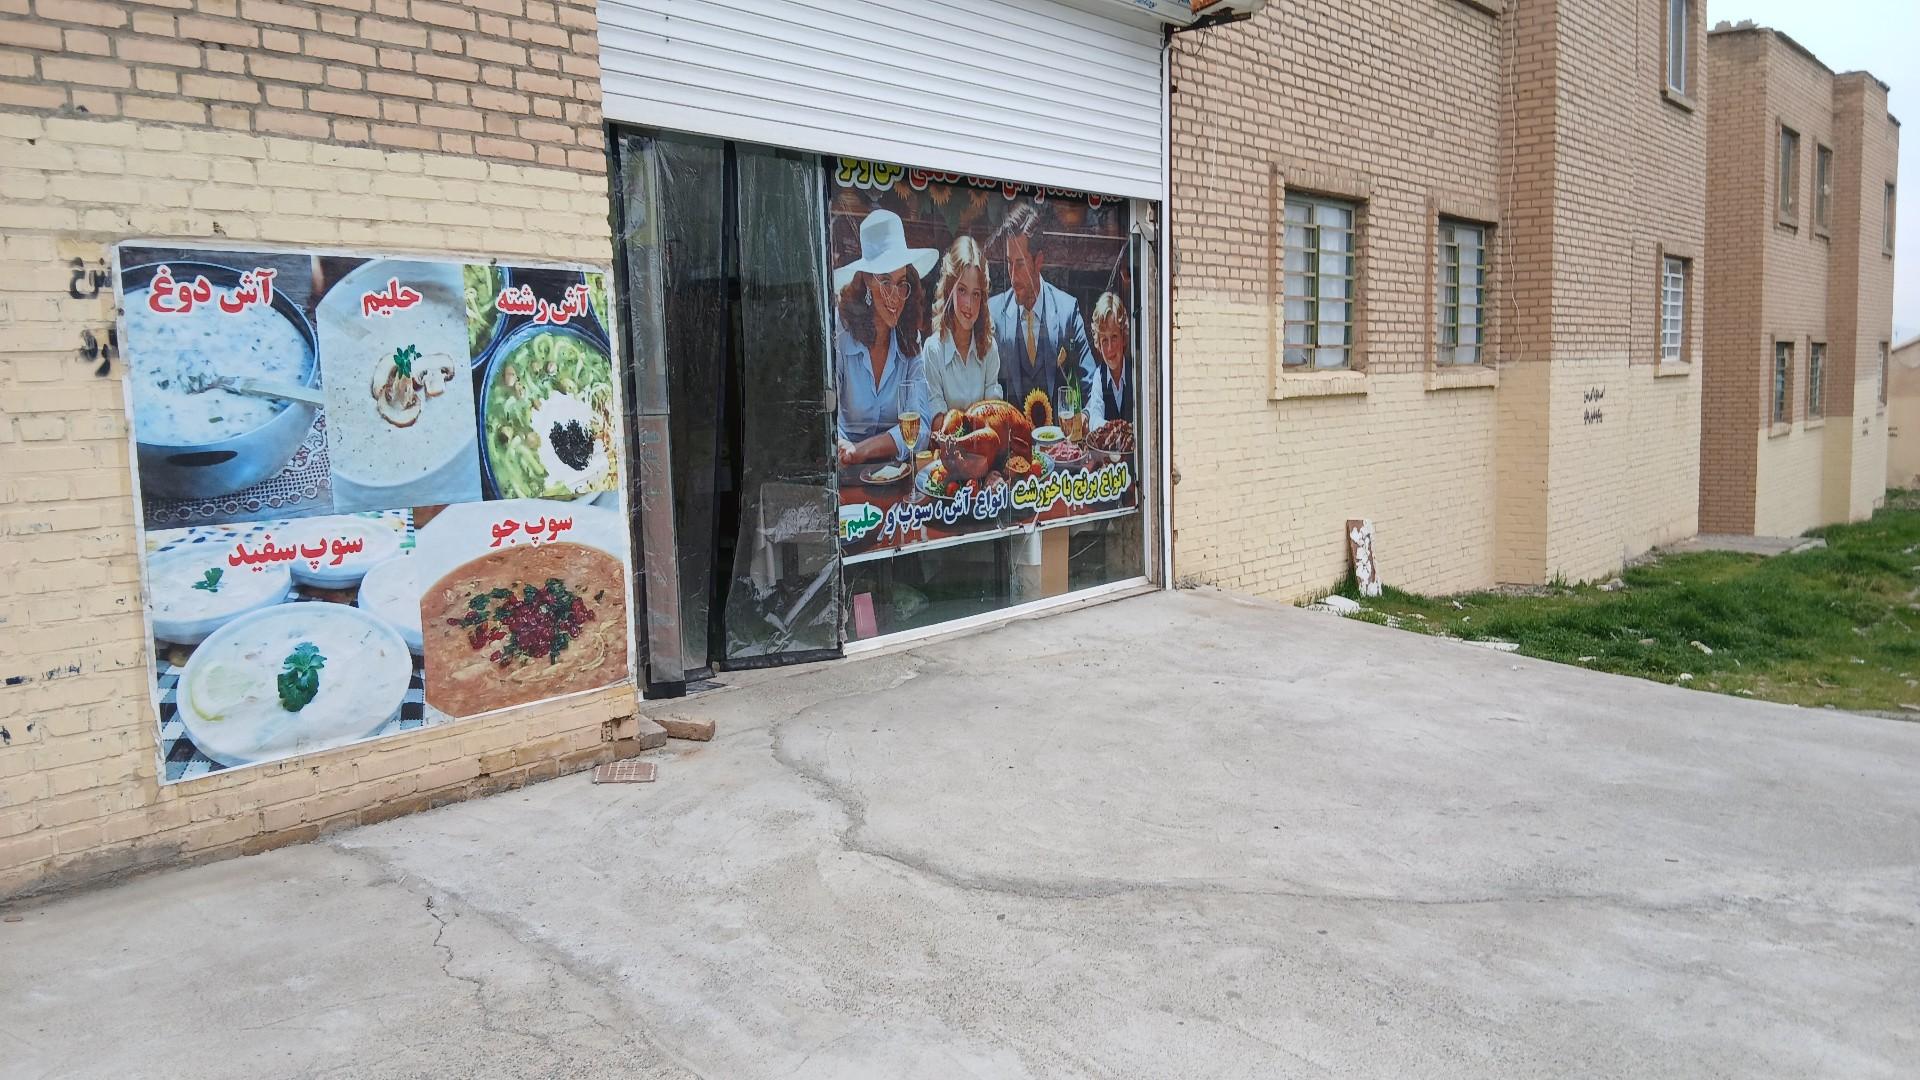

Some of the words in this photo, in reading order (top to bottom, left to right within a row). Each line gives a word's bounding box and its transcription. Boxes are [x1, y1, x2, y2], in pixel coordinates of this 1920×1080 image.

[149, 267, 211, 314] دوغ
[219, 269, 274, 314] آش
[362, 279, 421, 316] حلیم
[498, 287, 548, 321] رشته
[551, 286, 588, 321] آش
[1013, 475, 1060, 507] خورشت
[1062, 473, 1072, 503] با
[1073, 471, 1098, 501] برنج
[1100, 464, 1127, 496] انواع
[974, 480, 1008, 518] انواع
[490, 519, 520, 548] جو
[525, 516, 573, 544] سوپ
[846, 504, 882, 539] حلیم
[886, 510, 895, 534] و
[898, 503, 931, 531] سوپ
[228, 534, 297, 573] سفید
[300, 537, 363, 570] سوپ
